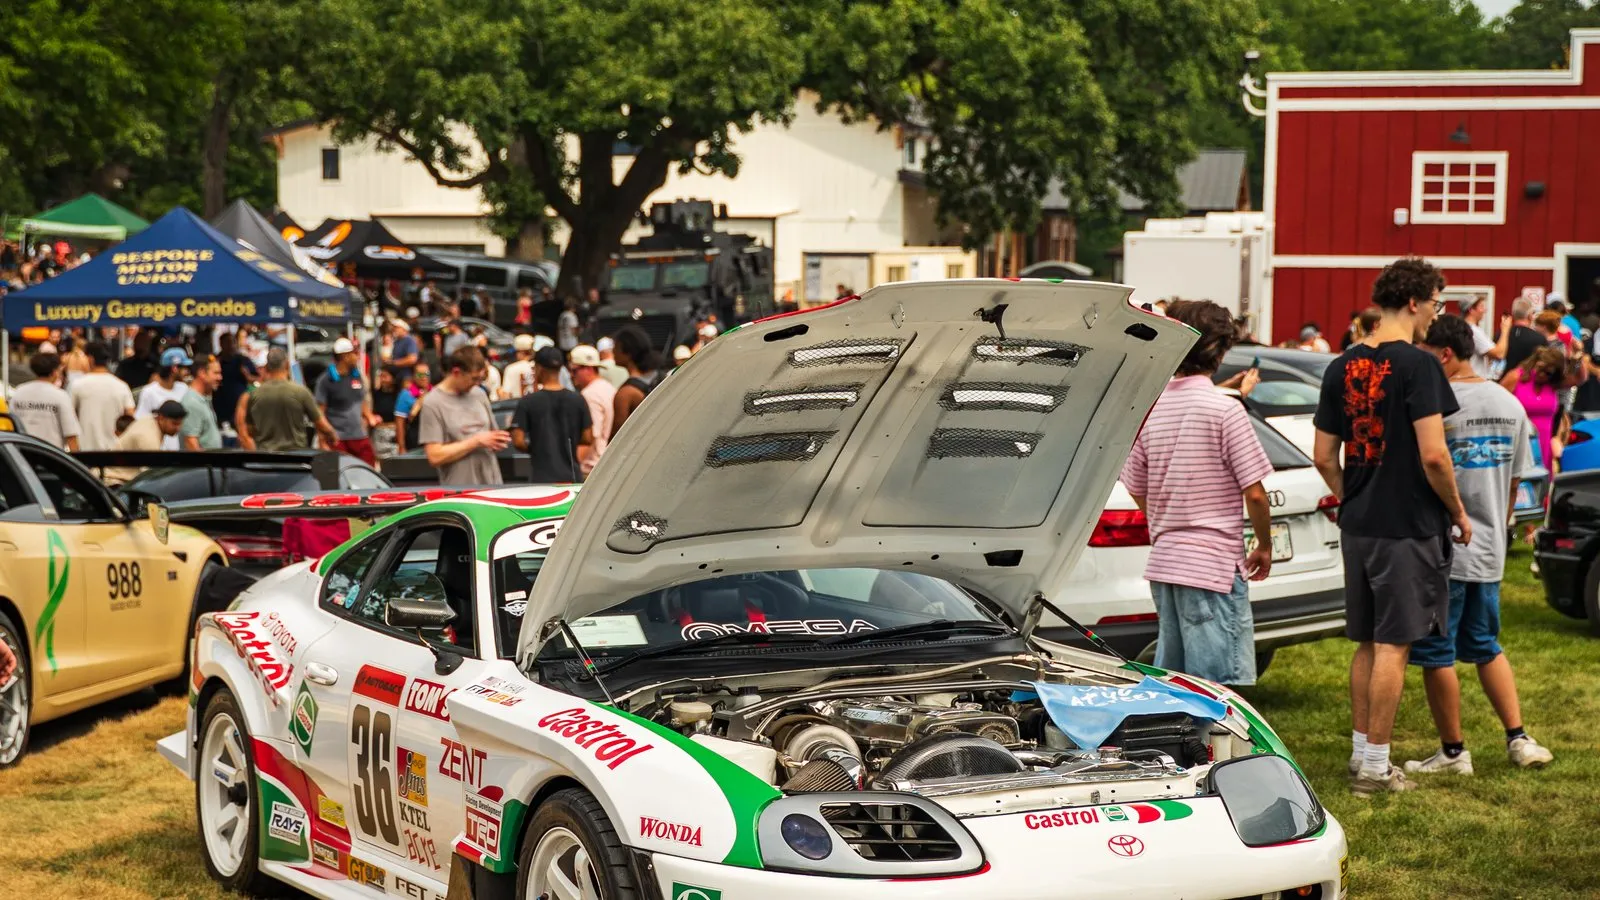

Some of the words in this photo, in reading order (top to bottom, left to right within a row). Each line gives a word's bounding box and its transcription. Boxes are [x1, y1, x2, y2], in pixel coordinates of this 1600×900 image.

[112, 250, 214, 264] BESPOKE
[116, 261, 198, 274] MOTOR
[117, 273, 193, 285] UNION
[35, 303, 102, 322] Luxury
[107, 300, 176, 321] Garage
[181, 298, 256, 317] Condos
[107, 561, 142, 600] 988
[269, 620, 297, 656] TOYOTA
[681, 619, 880, 642] OMEGA
[538, 708, 654, 770] Castrol
[352, 703, 399, 846] 36
[438, 736, 487, 788] ZENT
[272, 813, 303, 833] RAYS
[399, 801, 431, 832] KTEL
[466, 811, 499, 849] TRD
[1024, 807, 1100, 830] Castrol
[640, 816, 703, 847] WONDA
[395, 876, 428, 900] FET
